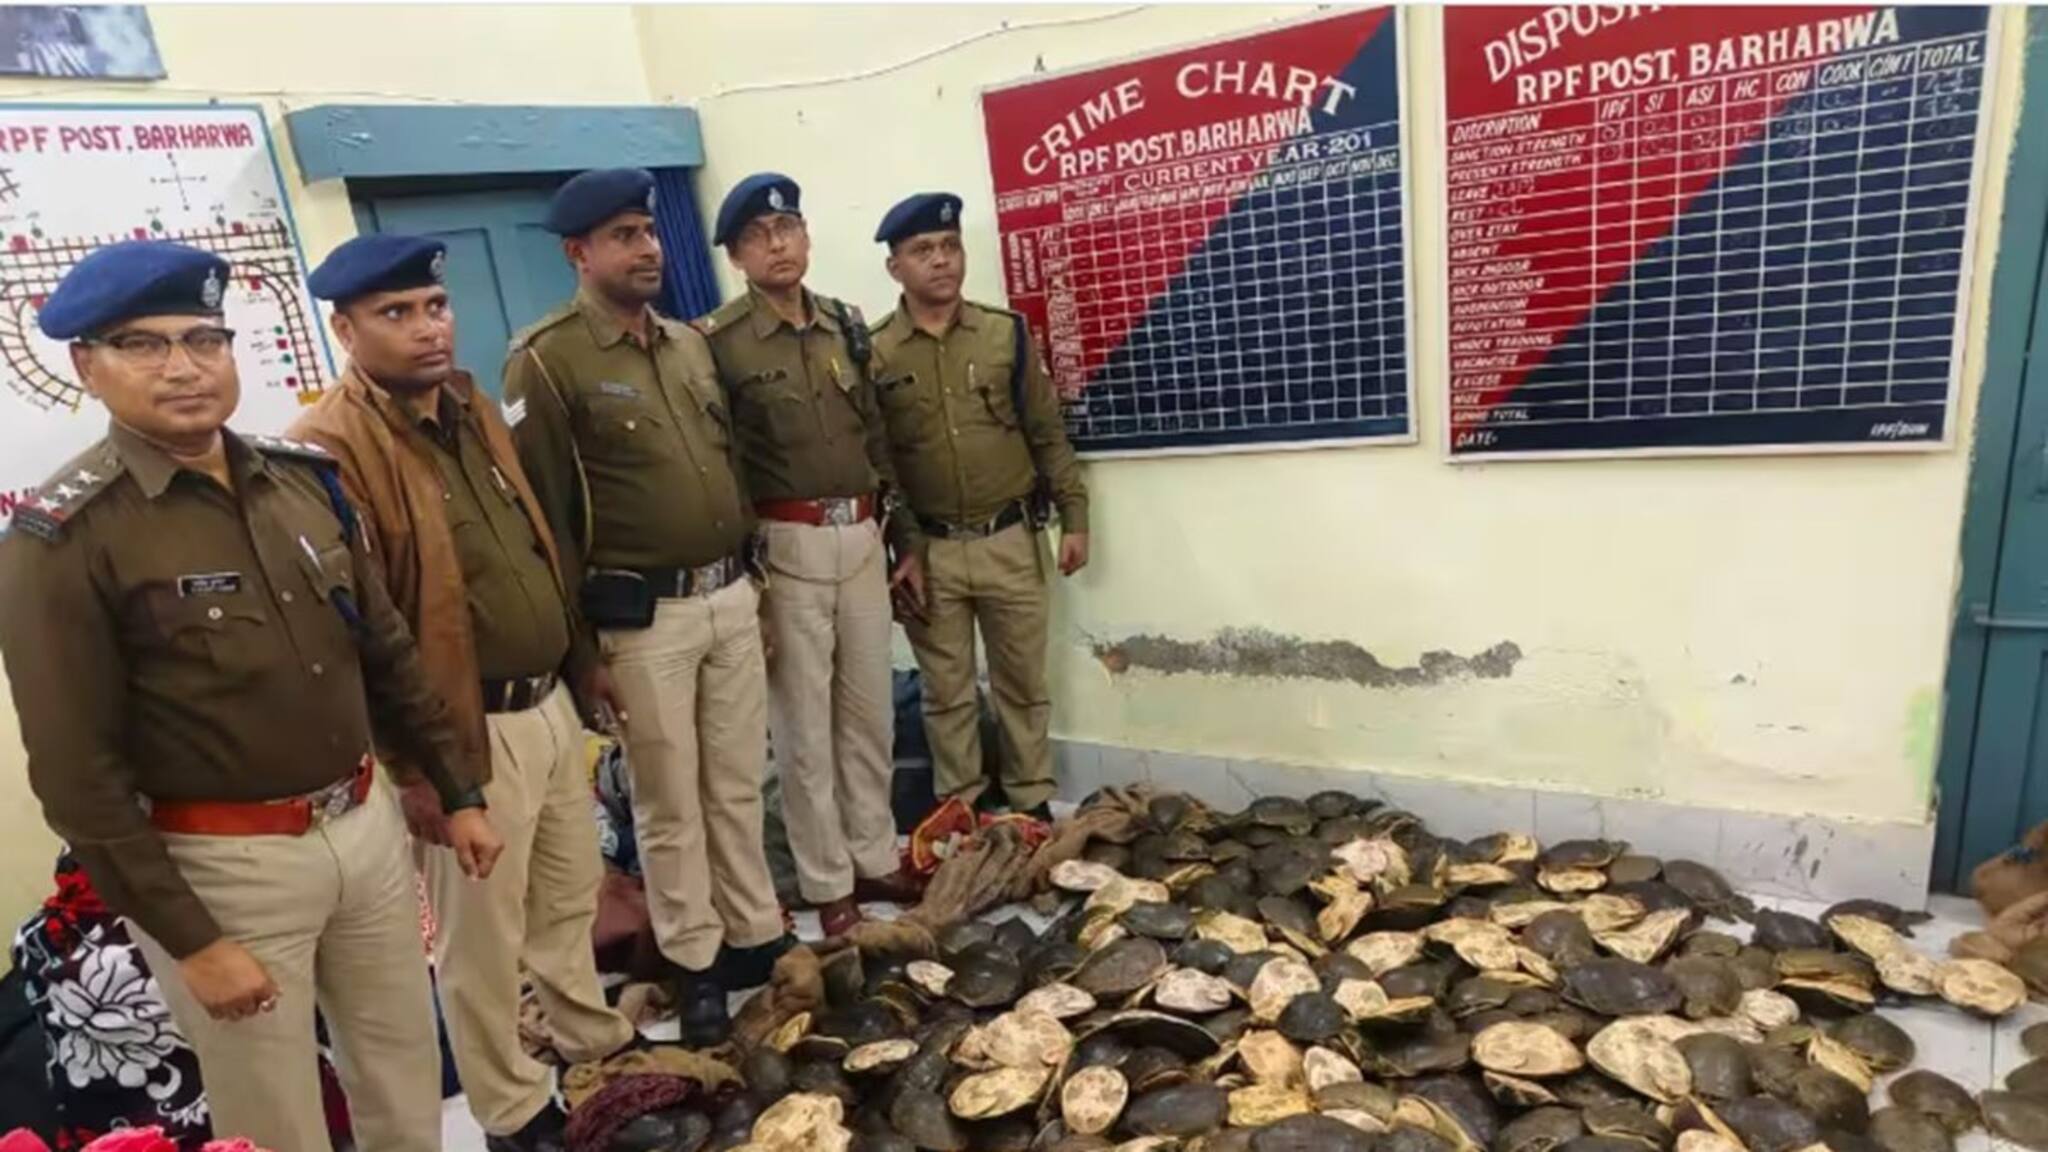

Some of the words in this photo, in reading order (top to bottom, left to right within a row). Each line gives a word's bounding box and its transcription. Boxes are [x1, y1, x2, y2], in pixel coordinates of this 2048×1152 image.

[1517, 65, 1582, 104] RPF
[1689, 8, 1900, 77] BARHARWA
[1601, 97, 1630, 119] IPF
[1645, 92, 1666, 114] SI
[1686, 84, 1716, 107] ASI
[1734, 78, 1760, 100] HC
[1775, 69, 1809, 92] CON
[1819, 60, 1863, 86] COOK
[1921, 40, 1980, 70] TOTAL
[1022, 78, 1147, 176] CRIME
[1175, 60, 1356, 117] CHART
[134, 123, 254, 149] BARHARWA
[1451, 143, 1514, 163] SANCTION
[1514, 132, 1587, 155] STRENGTH
[1060, 144, 1111, 178] RPF
[1123, 154, 1243, 191] CURRENT
[1450, 163, 1509, 182] PRESENT
[1509, 154, 1582, 173] STRENGTH
[1451, 186, 1490, 202] LEAVE
[1451, 206, 1484, 222] REST
[1486, 222, 1519, 238] STAY
[1451, 244, 1501, 260] ABSENT
